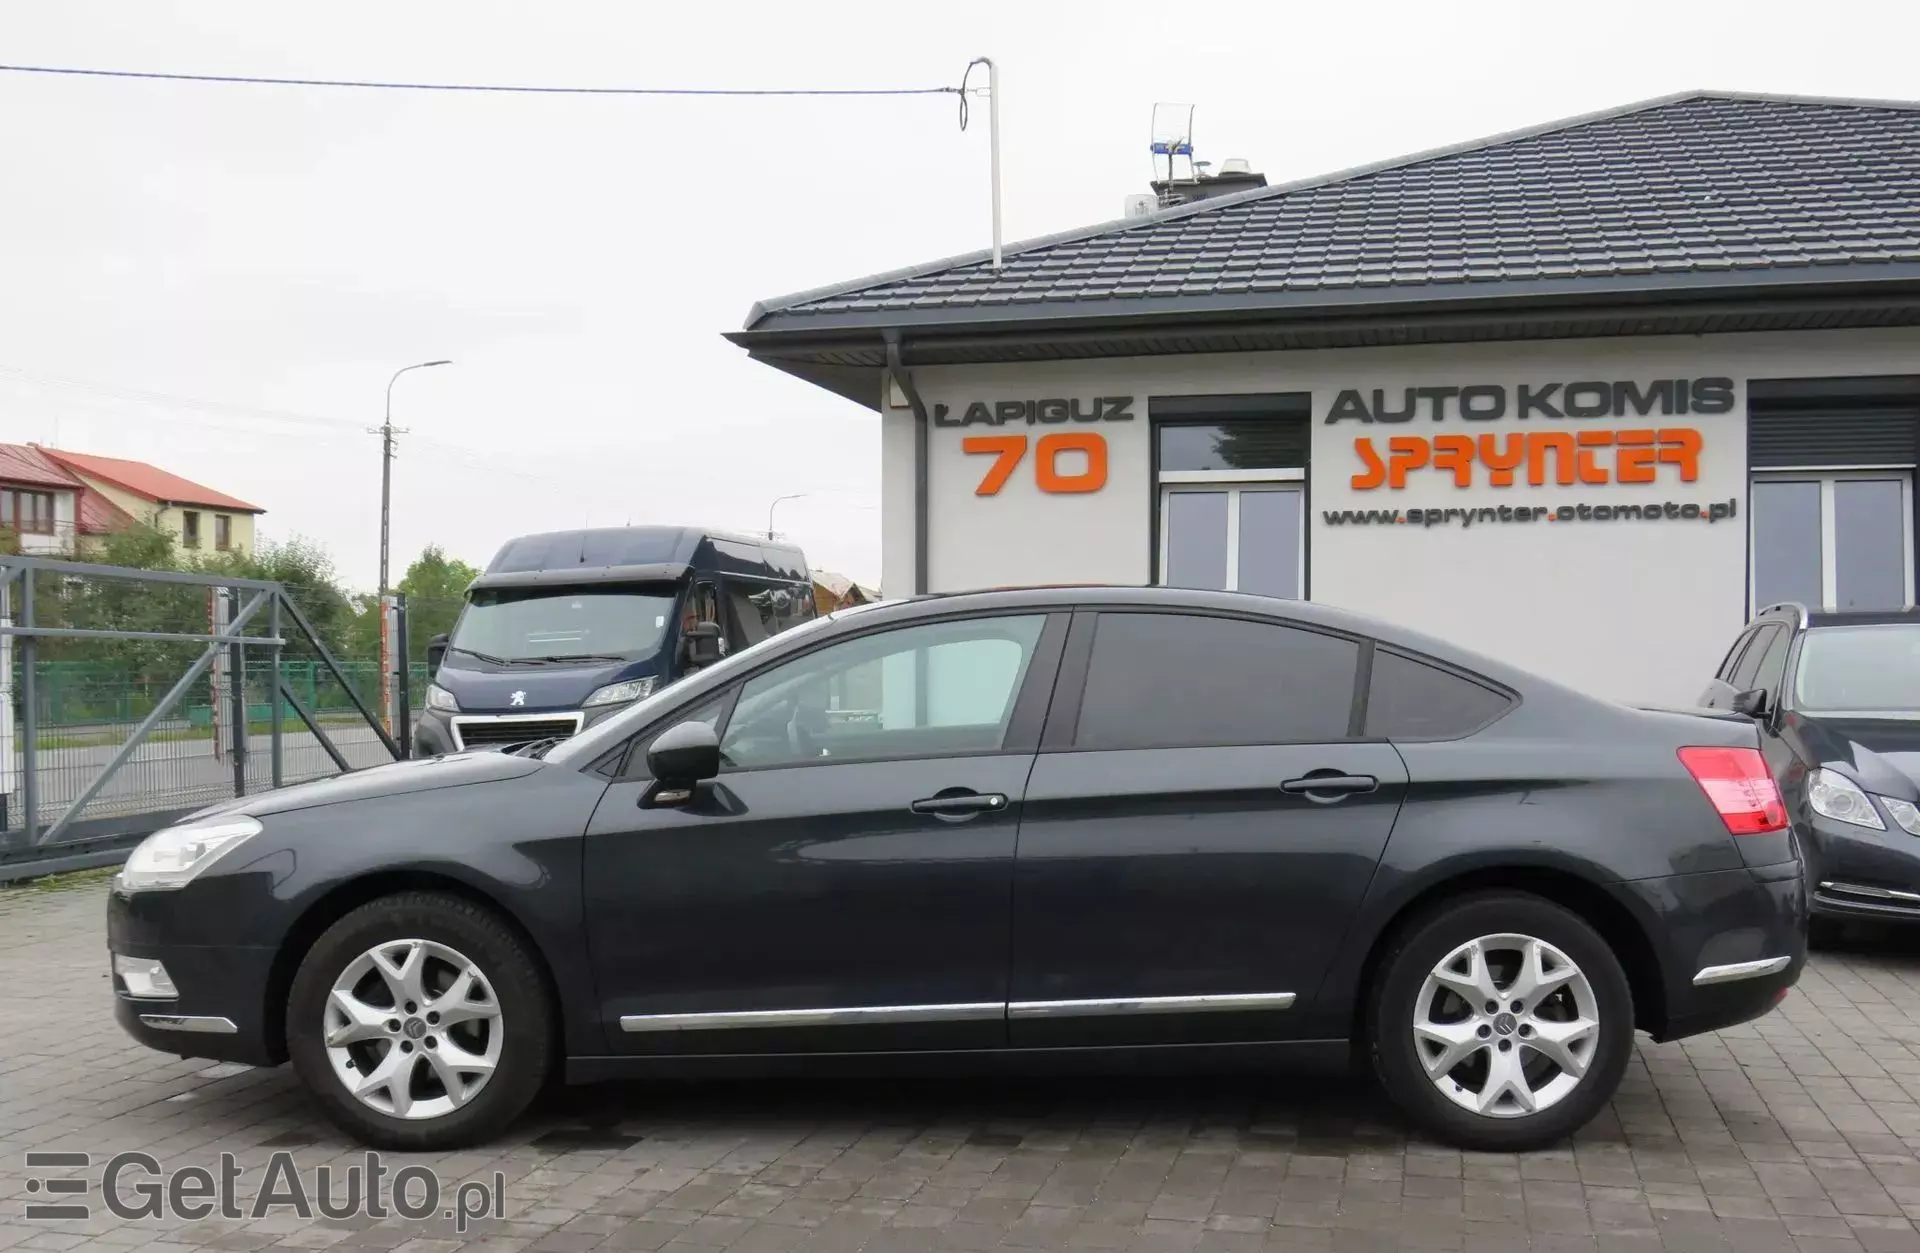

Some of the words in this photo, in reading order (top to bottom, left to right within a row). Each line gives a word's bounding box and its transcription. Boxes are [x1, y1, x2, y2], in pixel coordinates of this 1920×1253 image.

[935, 396, 1134, 427] ŁAPIGUZ
[1324, 384, 1507, 425] AUTO
[1518, 376, 1736, 419] KOMIS
[962, 432, 1109, 496] 70
[1351, 428, 1704, 490] SPRYNTER
[1322, 498, 1737, 529] www.sprynter.otomoto.pl
